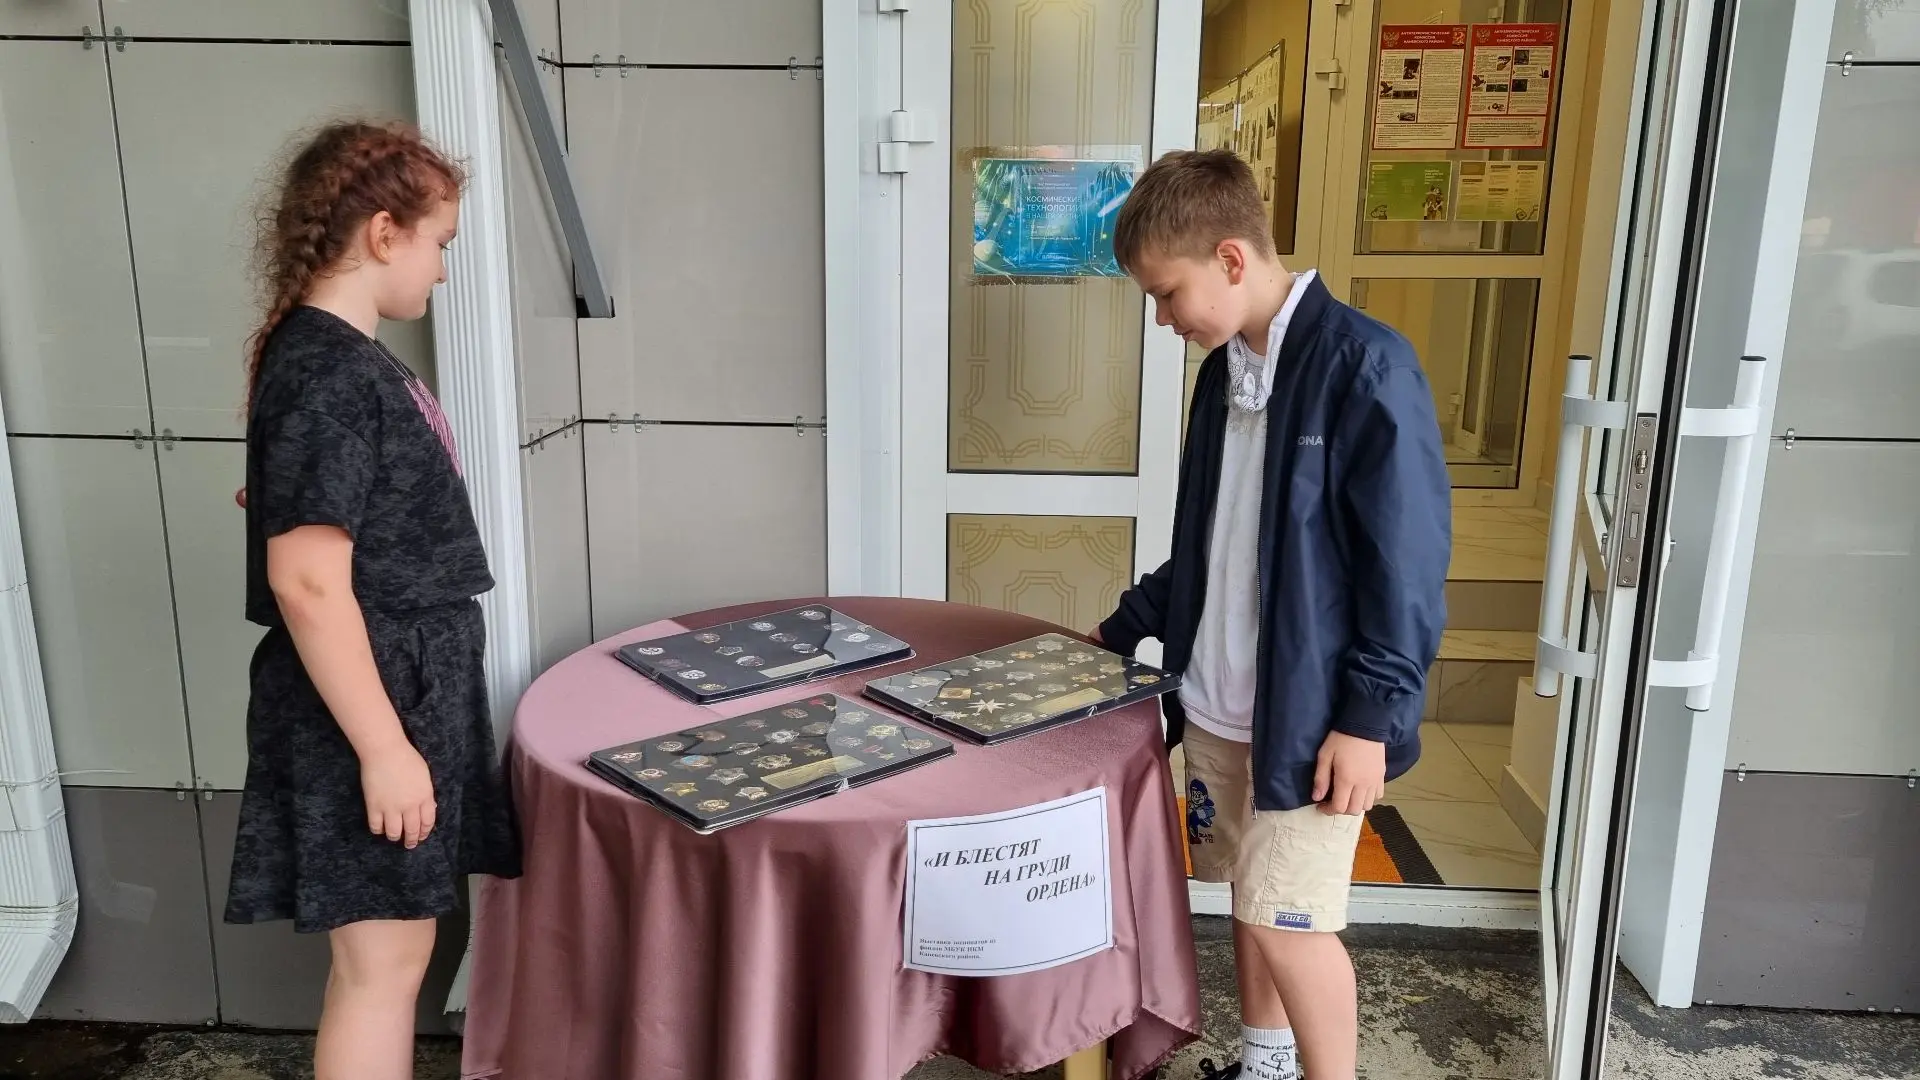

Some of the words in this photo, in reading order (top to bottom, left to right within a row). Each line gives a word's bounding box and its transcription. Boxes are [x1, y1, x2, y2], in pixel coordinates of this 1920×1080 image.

[1026, 195, 1081, 203] КОСМИЧЕСКИЕ
[1026, 204, 1081, 212] ТЕХНОЛОГИИ
[924, 851, 952, 868] «И
[954, 838, 1042, 866] БЛЕСТЯТ
[984, 869, 1011, 886] НА
[1016, 854, 1072, 881] ГРУДИ
[1026, 871, 1097, 902] ОРДЕНА»
[1255, 1068, 1270, 1079] ТЫ
